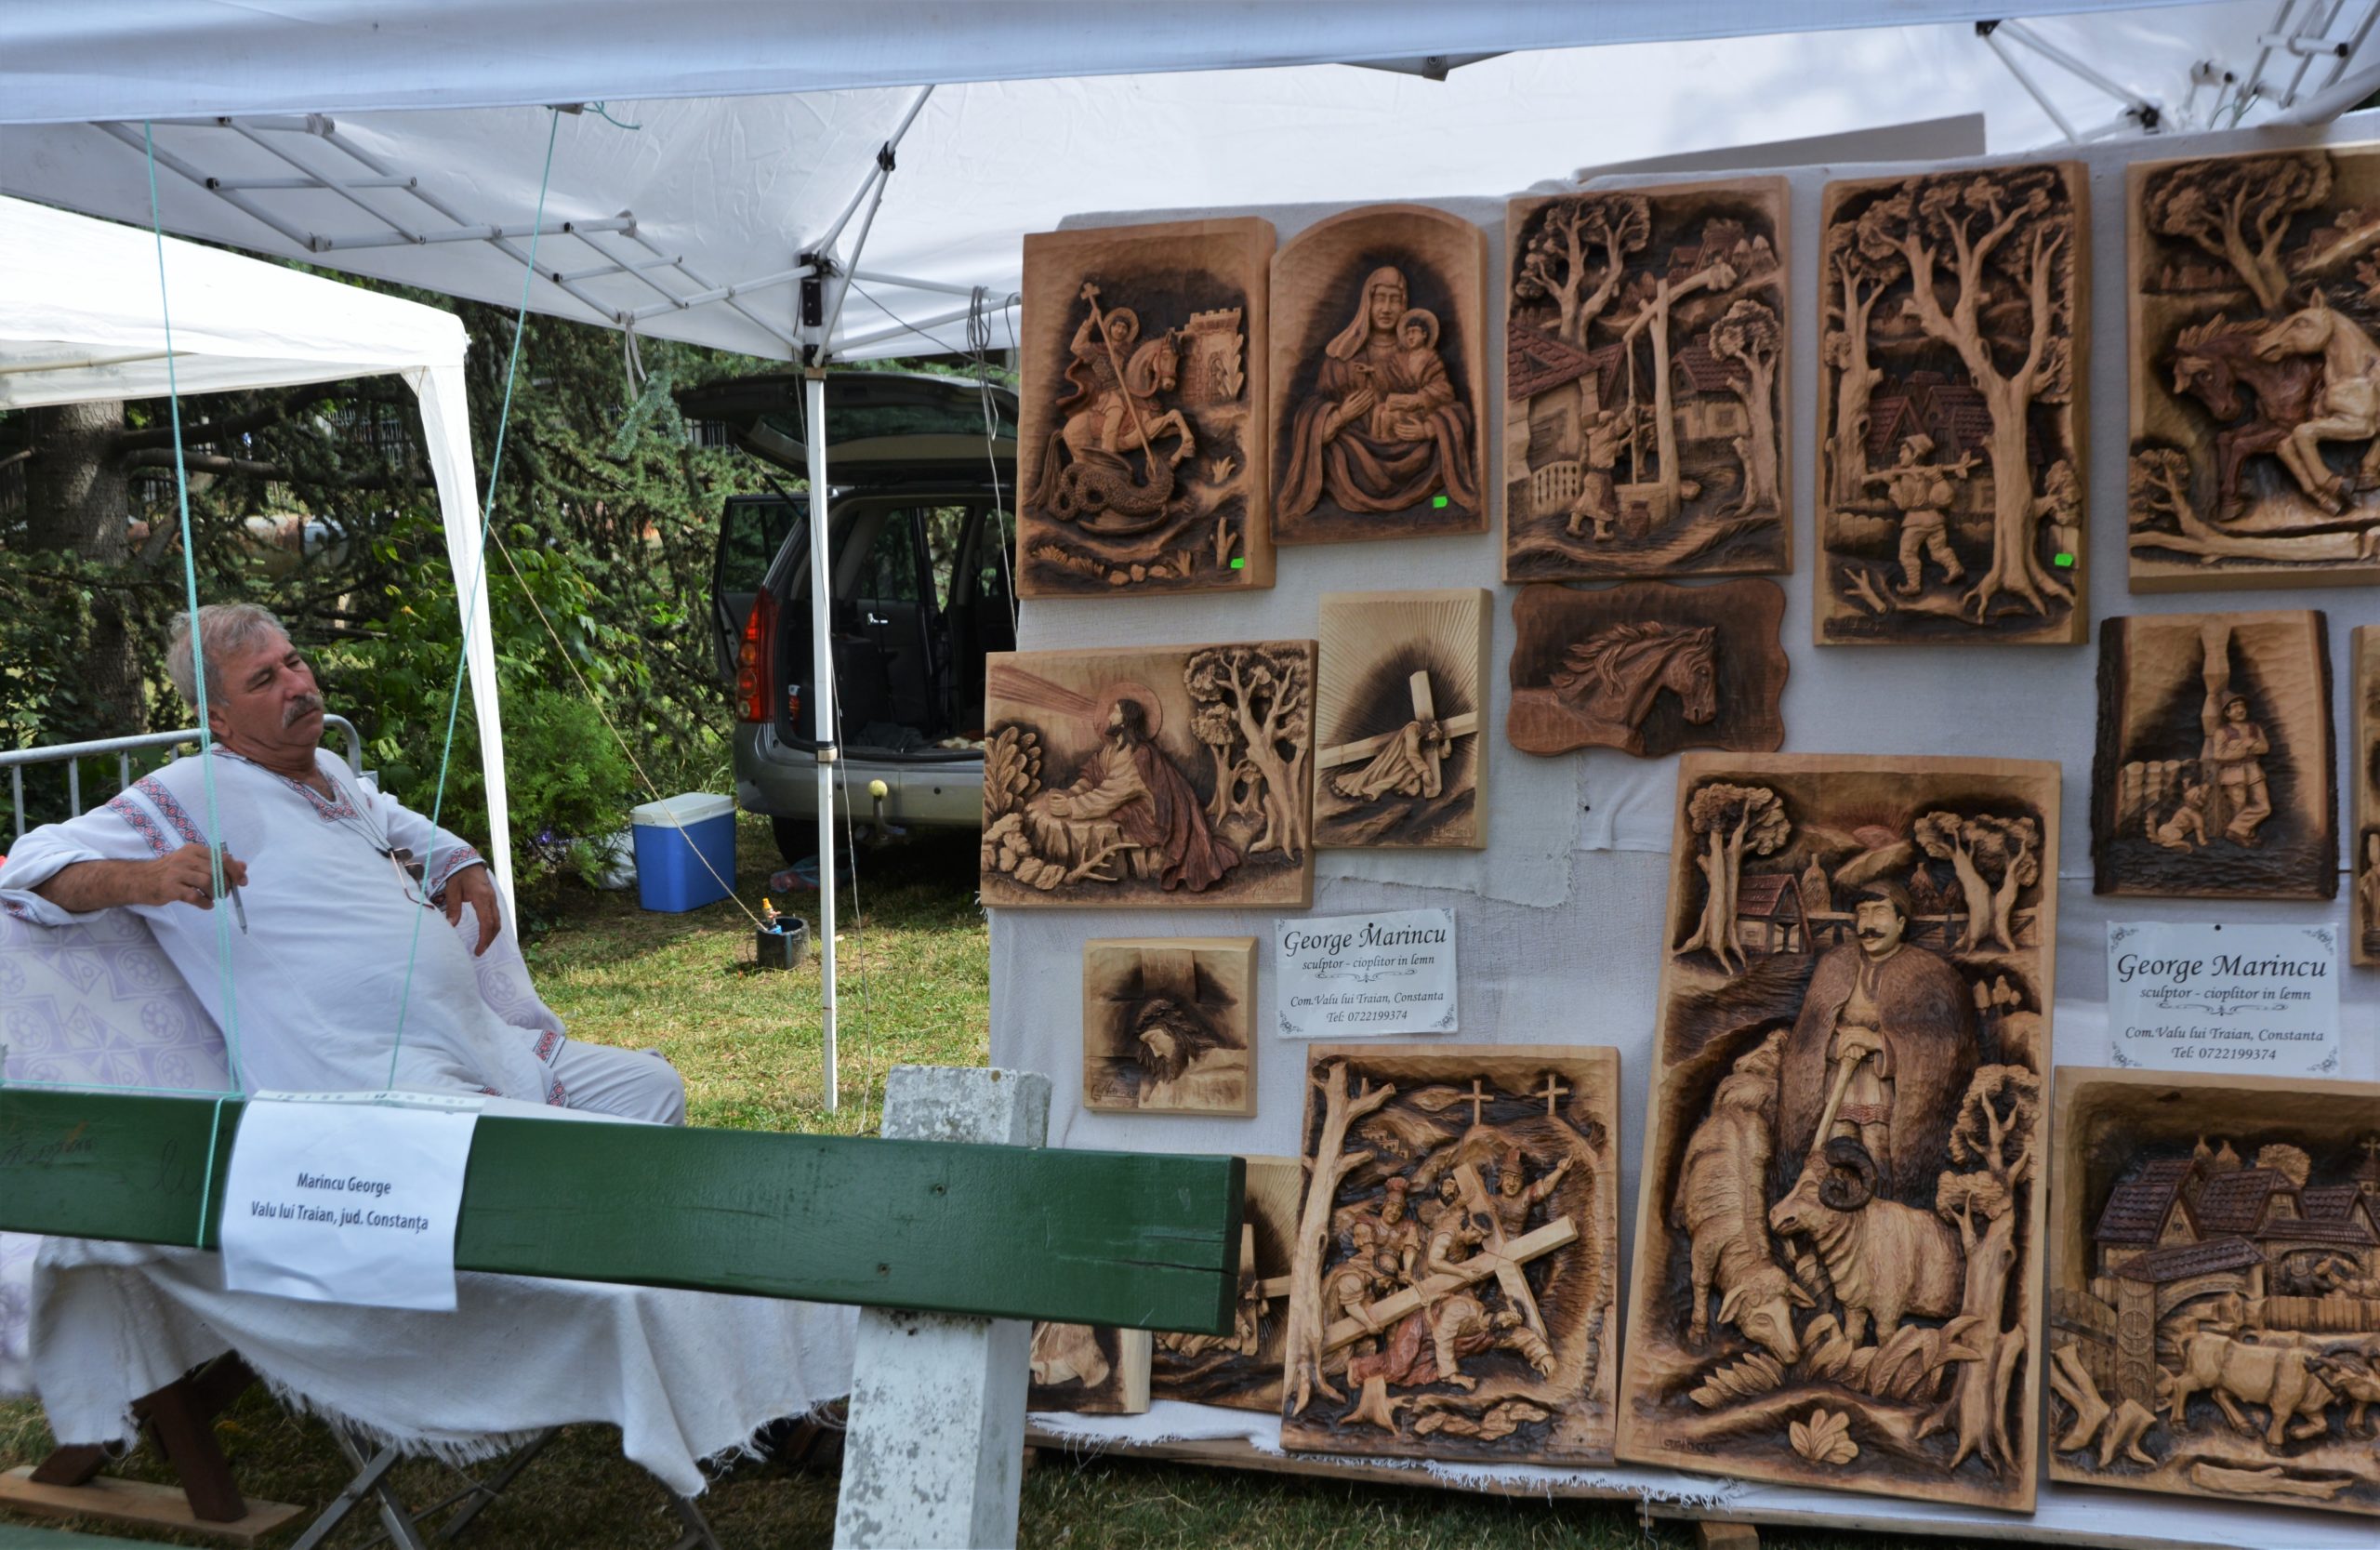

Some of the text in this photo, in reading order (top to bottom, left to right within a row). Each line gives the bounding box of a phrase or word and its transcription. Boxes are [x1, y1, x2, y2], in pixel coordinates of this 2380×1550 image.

[1284, 927, 1447, 957] George Marincu
[1302, 958, 1343, 973] sculptor
[1353, 955, 1396, 971] cioplitor
[1398, 955, 1408, 965] in
[1410, 953, 1435, 964] lemn
[2117, 954, 2327, 983] George Marincu
[1341, 994, 1354, 1004] lui
[1355, 994, 1391, 1004] Traian,
[1394, 992, 1444, 1003] Constanta
[2139, 985, 2193, 1000] sculptor
[2203, 986, 2260, 1002] cioplitor
[2262, 987, 2276, 1000] in
[2280, 987, 2312, 1000] lemn
[1326, 1010, 1408, 1023] Tel: 0722199374
[2189, 1027, 2207, 1040] lui
[2209, 1027, 2254, 1041] Traian,
[2258, 1028, 2324, 1041] Constanta
[2171, 1046, 2276, 1060] Tel: 0722199374
[297, 1172, 391, 1198] Marincu George
[251, 1201, 429, 1234] Valu lui Traian, jud. Constanța
